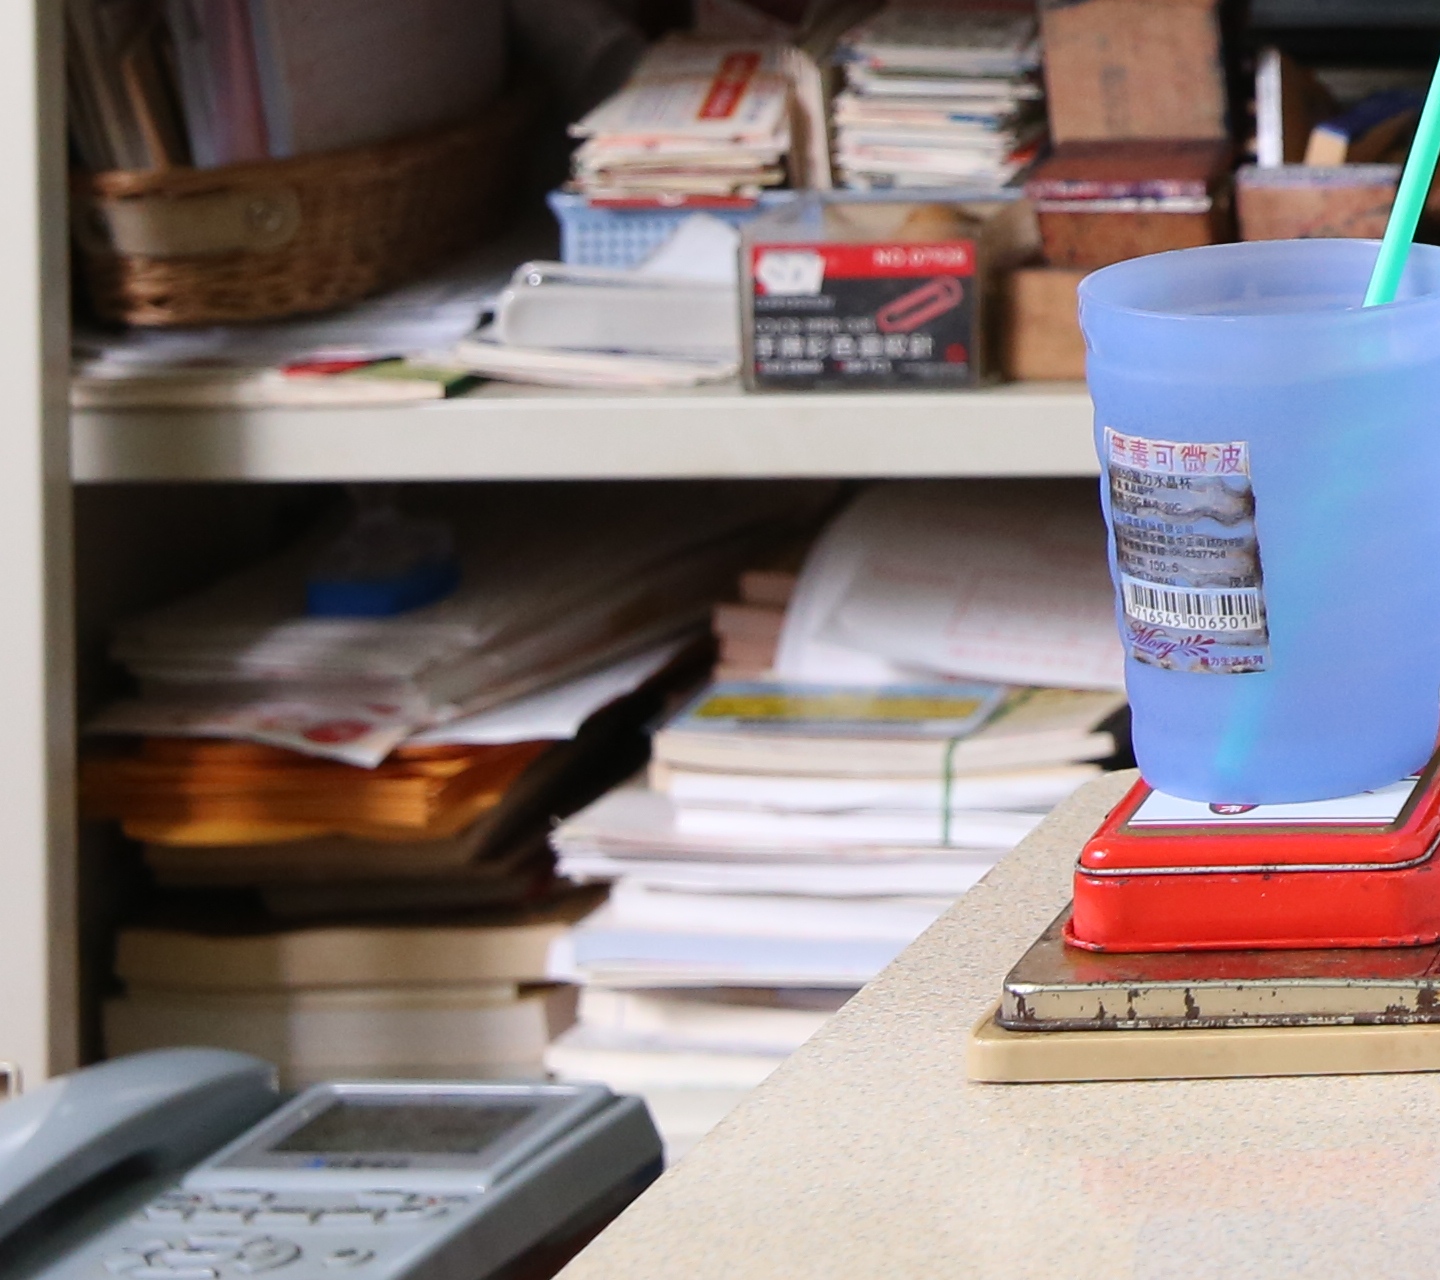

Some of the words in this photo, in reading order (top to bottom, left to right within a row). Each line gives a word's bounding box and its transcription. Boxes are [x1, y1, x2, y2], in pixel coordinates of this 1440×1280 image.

[1111, 433, 1243, 474] 無毒可微波
[1127, 621, 1178, 659] Mory
